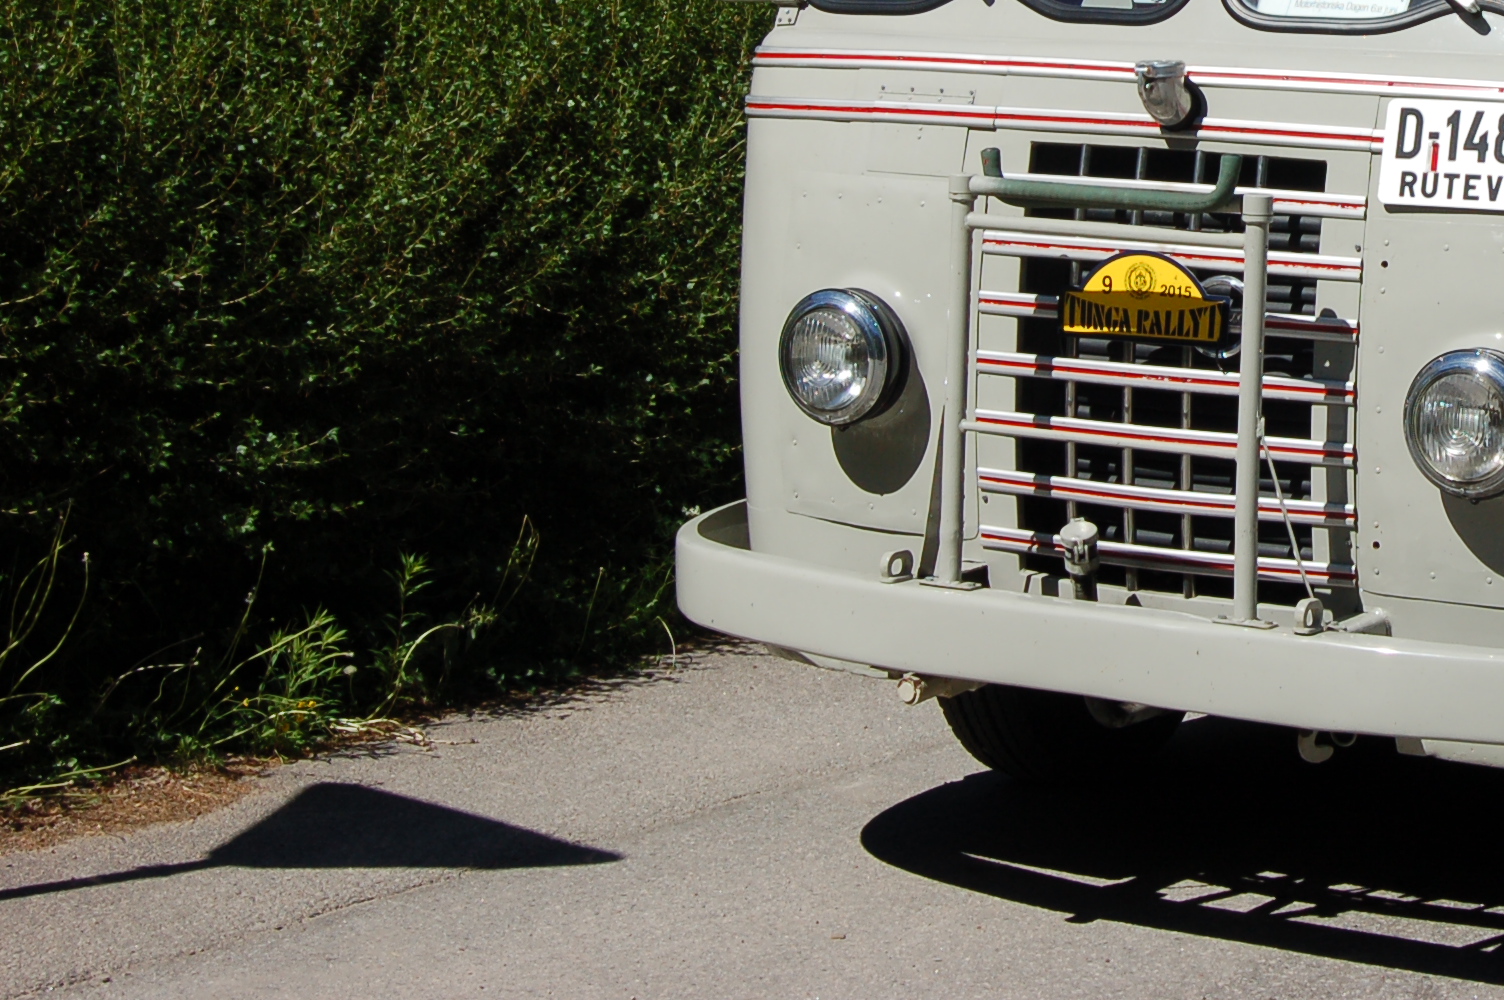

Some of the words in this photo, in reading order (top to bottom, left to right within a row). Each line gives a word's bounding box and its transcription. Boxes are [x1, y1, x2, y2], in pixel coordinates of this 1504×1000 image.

[1346, 2, 1369, 13] Dagen
[1102, 275, 1113, 294] 9
[1160, 284, 1192, 299] 2015
[1065, 292, 1131, 332] TUNGA
